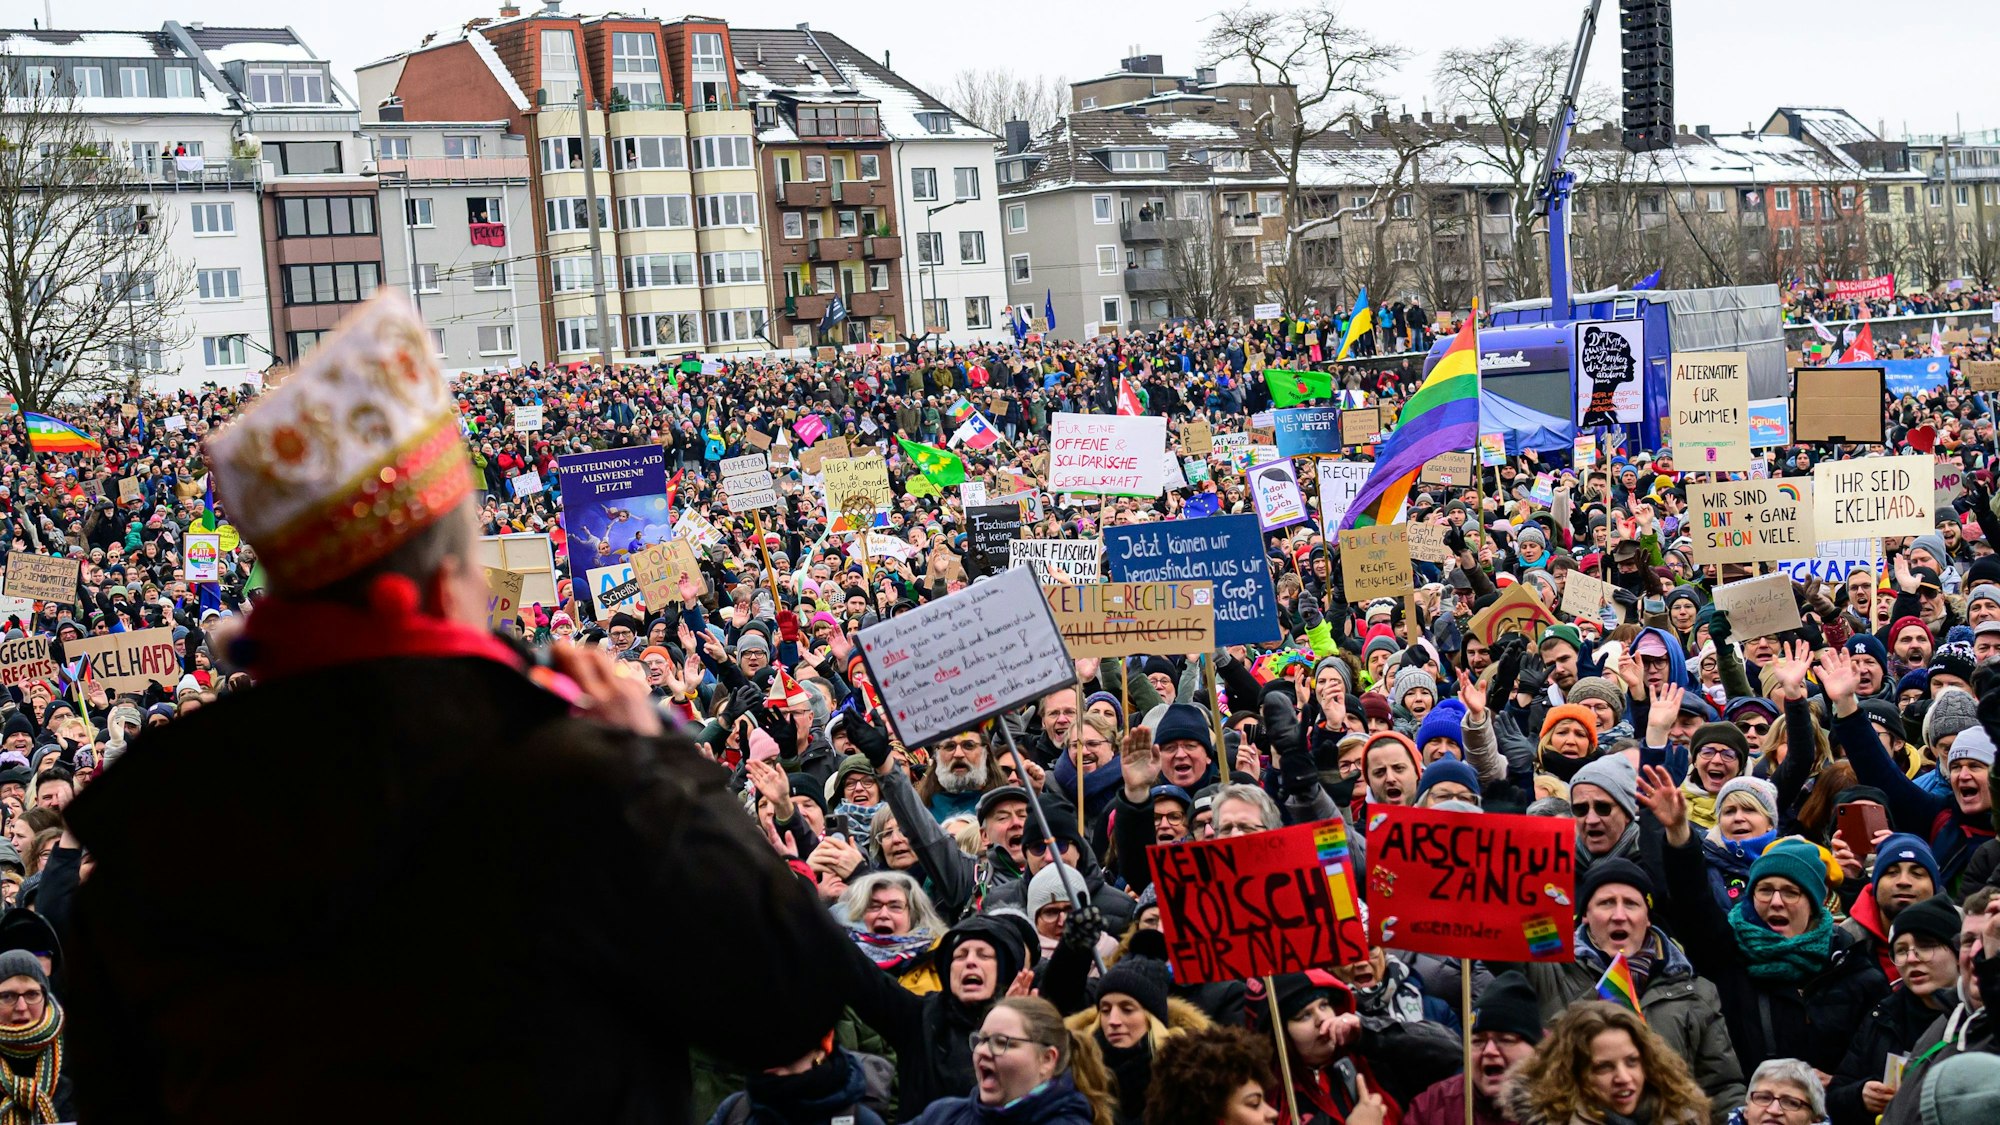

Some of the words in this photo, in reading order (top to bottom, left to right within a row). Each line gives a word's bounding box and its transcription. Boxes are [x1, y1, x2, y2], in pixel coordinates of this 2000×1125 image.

[1605, 333, 1622, 348] Kopf
[1598, 350, 1628, 364] Denken
[1586, 361, 1601, 373] die
[1601, 363, 1628, 372] Richtung
[1676, 364, 1738, 380] ALTERNATIVE
[1276, 414, 1294, 424] NIE
[1295, 412, 1335, 422] WIEDER
[1283, 423, 1299, 433] IST
[1300, 421, 1331, 431] JETZT!
[1054, 438, 1110, 451] OFFENE
[1114, 439, 1128, 451] &
[559, 459, 631, 474] WERTEUNION
[642, 454, 663, 465] AFD
[723, 457, 764, 472] AUFHETZEN
[825, 461, 849, 474] HIER
[854, 459, 884, 471] KOMMT
[726, 477, 762, 490] FALSCH
[848, 473, 859, 481] die
[1053, 472, 1143, 489] GESELLSCHAFT
[1835, 472, 1864, 493] IHR
[1870, 469, 1910, 492] SEID
[1263, 482, 1287, 496] Adolf
[731, 493, 774, 509] DARSTELLEN
[1702, 492, 1728, 508] WIR
[1733, 489, 1767, 506] SIND
[971, 513, 1021, 531] Faschismus
[1703, 511, 1733, 528] BUNT
[1760, 507, 1797, 523] GANZ
[975, 533, 986, 543] ist
[989, 532, 1012, 541] keine
[1409, 523, 1435, 537] Geht
[1707, 530, 1752, 548] SCHÖN
[1758, 527, 1800, 544] VIELE.
[1118, 533, 1162, 559] Jetzt
[1166, 533, 1208, 555] können
[1210, 531, 1231, 549] wir
[1407, 534, 1443, 547] wählen!
[191, 548, 210, 558] PLATZ
[1012, 541, 1048, 558] BRAUNE
[1051, 543, 1097, 561] FLASCHEN
[1056, 561, 1070, 574] IN
[1074, 562, 1097, 576] DEN
[1212, 562, 1239, 577] was
[1241, 556, 1263, 574] wir
[1360, 561, 1398, 574] RECHTE
[1355, 573, 1408, 589] MENSCHEN!
[1043, 584, 1113, 613] KETTE
[1124, 584, 1193, 610] RECHTS
[1720, 596, 1743, 610] Nie
[1743, 589, 1785, 607] wieder
[1105, 611, 1135, 620] STATT
[873, 634, 894, 649] Man
[895, 625, 918, 640] kann
[1060, 621, 1131, 646] ÄHLEN
[1136, 618, 1205, 642] RECHTS
[0, 639, 47, 665] GEGEN
[882, 649, 909, 666] ohne
[889, 670, 912, 685] Man
[913, 659, 935, 673] kann
[968, 634, 984, 647] und
[2, 660, 52, 686] RECHTS
[933, 665, 961, 682] ohne
[961, 652, 986, 671] links
[949, 684, 974, 698] kann
[995, 655, 1035, 675] Heimat
[973, 692, 996, 708] ohne
[1379, 821, 1495, 871] ARSCH
[1503, 829, 1571, 874] huh
[1150, 844, 1240, 884] KEIN
[1429, 861, 1540, 906] ZANG
[1245, 918, 1365, 980] NAZIS
